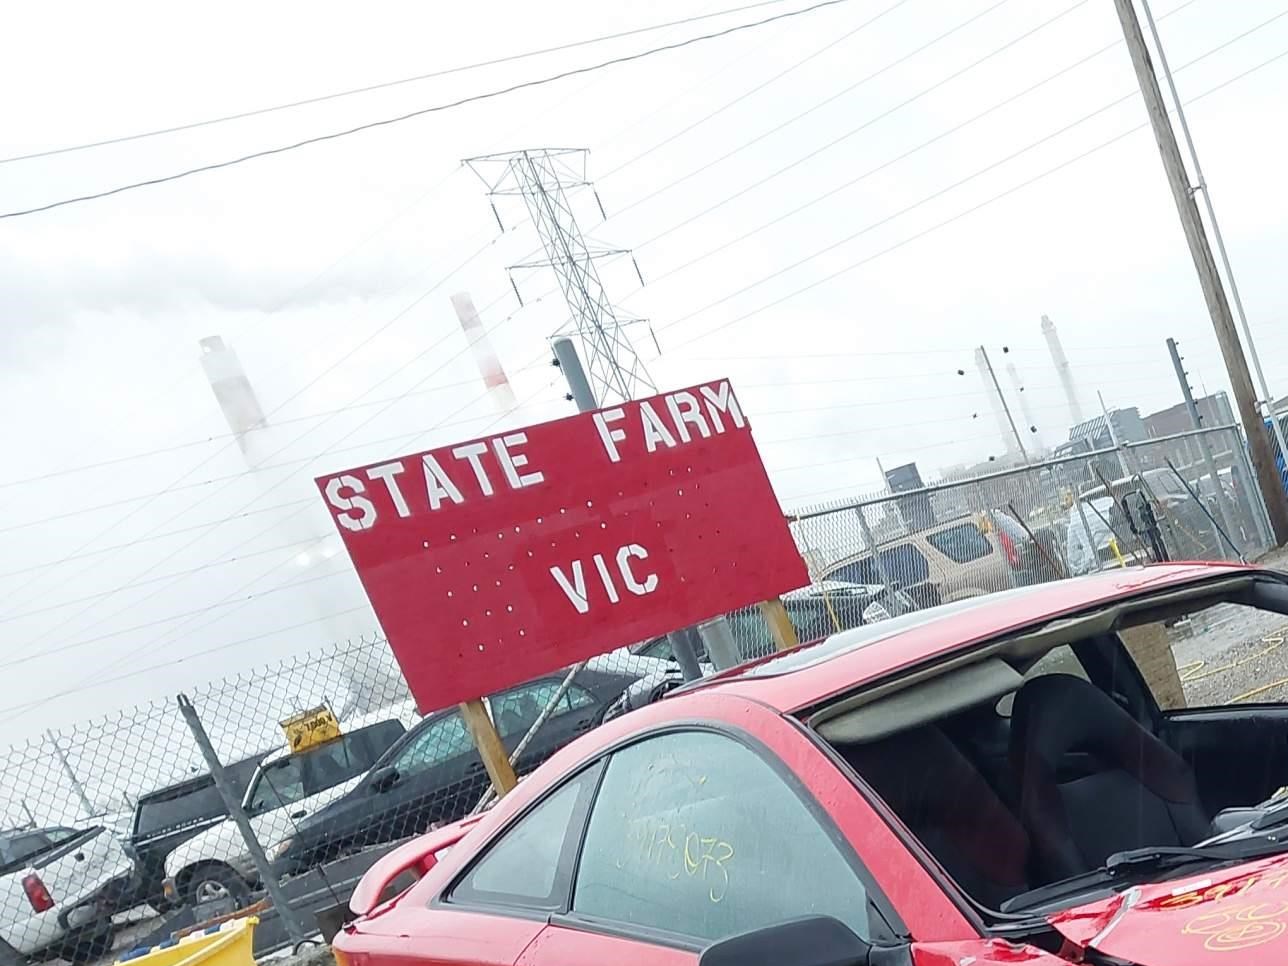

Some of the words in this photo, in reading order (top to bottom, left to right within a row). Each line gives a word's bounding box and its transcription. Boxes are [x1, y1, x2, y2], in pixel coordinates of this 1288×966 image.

[326, 433, 545, 532] STATE
[592, 381, 746, 463] FARM
[550, 543, 659, 614] VIC
